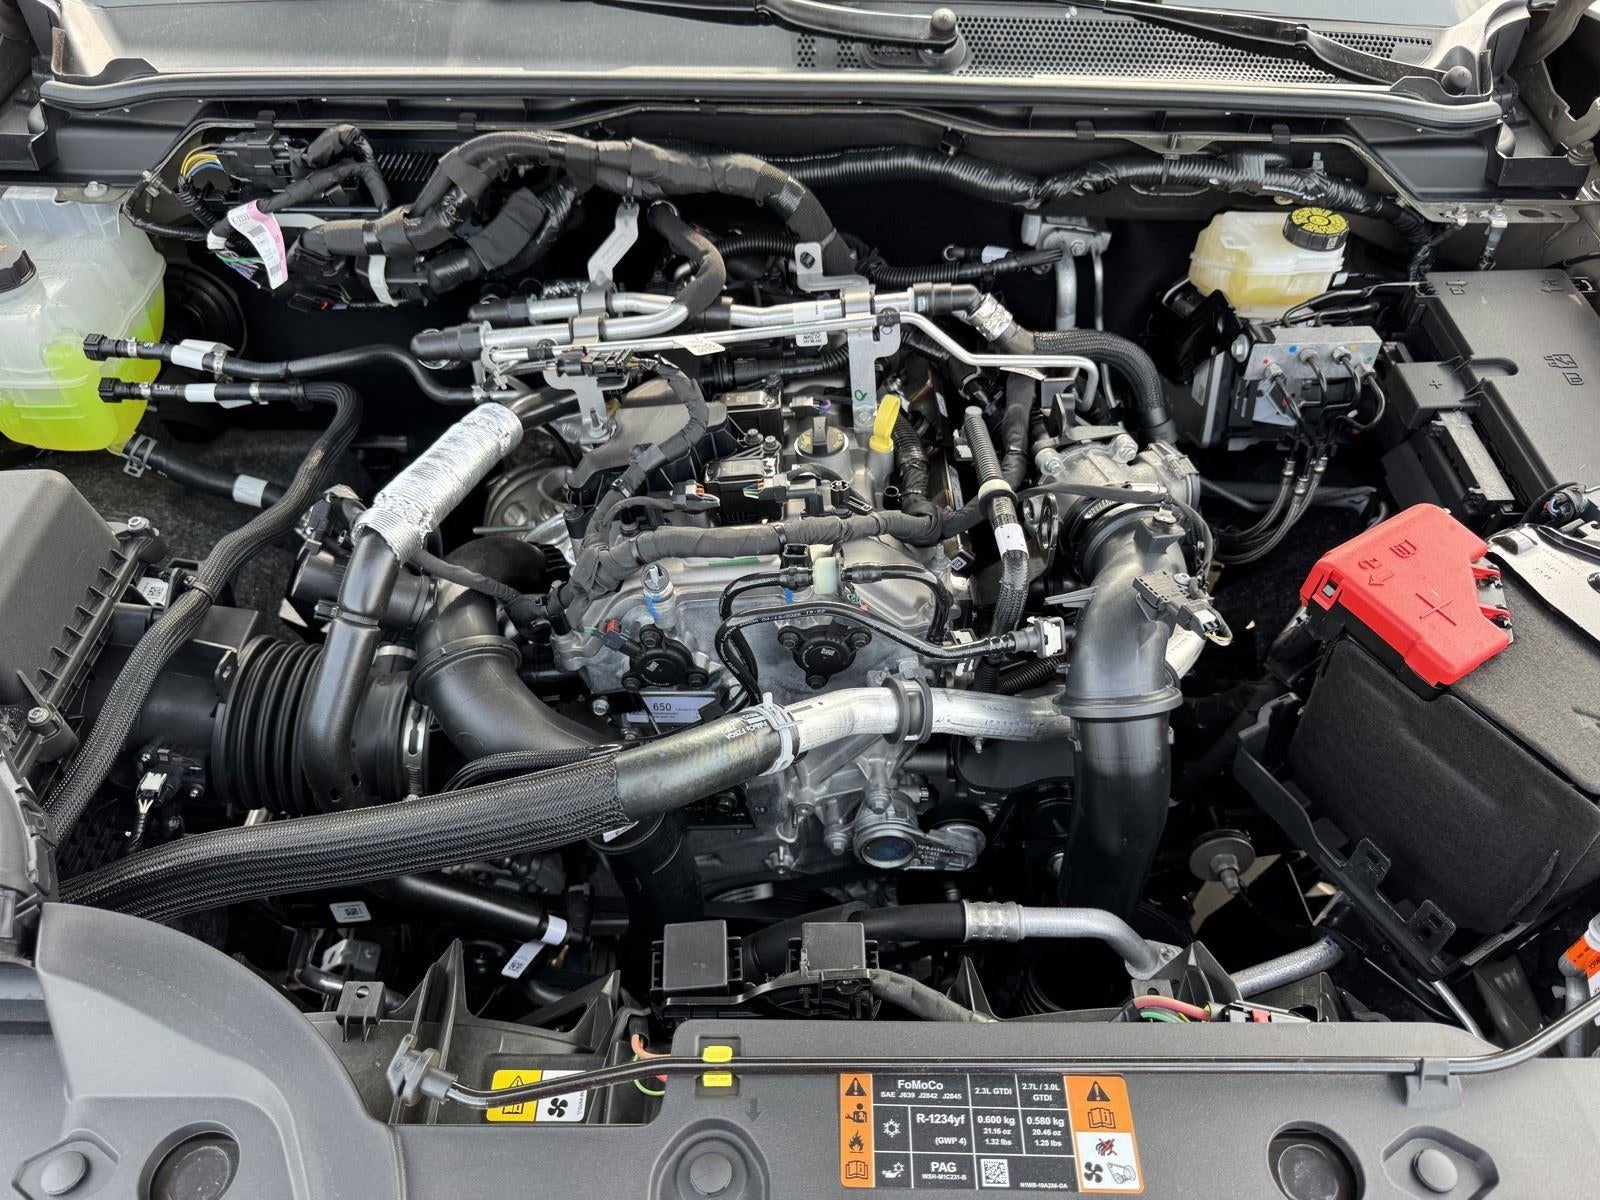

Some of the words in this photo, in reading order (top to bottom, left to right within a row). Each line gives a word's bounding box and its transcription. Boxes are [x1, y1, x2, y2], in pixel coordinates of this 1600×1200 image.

[653, 703, 672, 711] 650
[897, 1080, 944, 1090] FoMoCo
[1022, 1083, 1038, 1091] 2.7L
[1044, 1083, 1061, 1091] 3.0L
[974, 1087, 991, 1095] 2.3L
[993, 1087, 1012, 1095] GTDI
[1033, 1094, 1053, 1102] GTDI
[916, 1113, 966, 1127] R-1234yf
[977, 1115, 1002, 1124] 0.600
[1003, 1115, 1016, 1126] kg
[1026, 1116, 1051, 1125] 0.580
[1052, 1117, 1065, 1128] kg
[1032, 1128, 1051, 1136] 20.46
[935, 1136, 957, 1146] (GWP
[958, 1136, 967, 1147] 4)
[1000, 1138, 1012, 1146] lbs
[1050, 1139, 1063, 1147] lbs
[930, 1161, 957, 1173] PAG
